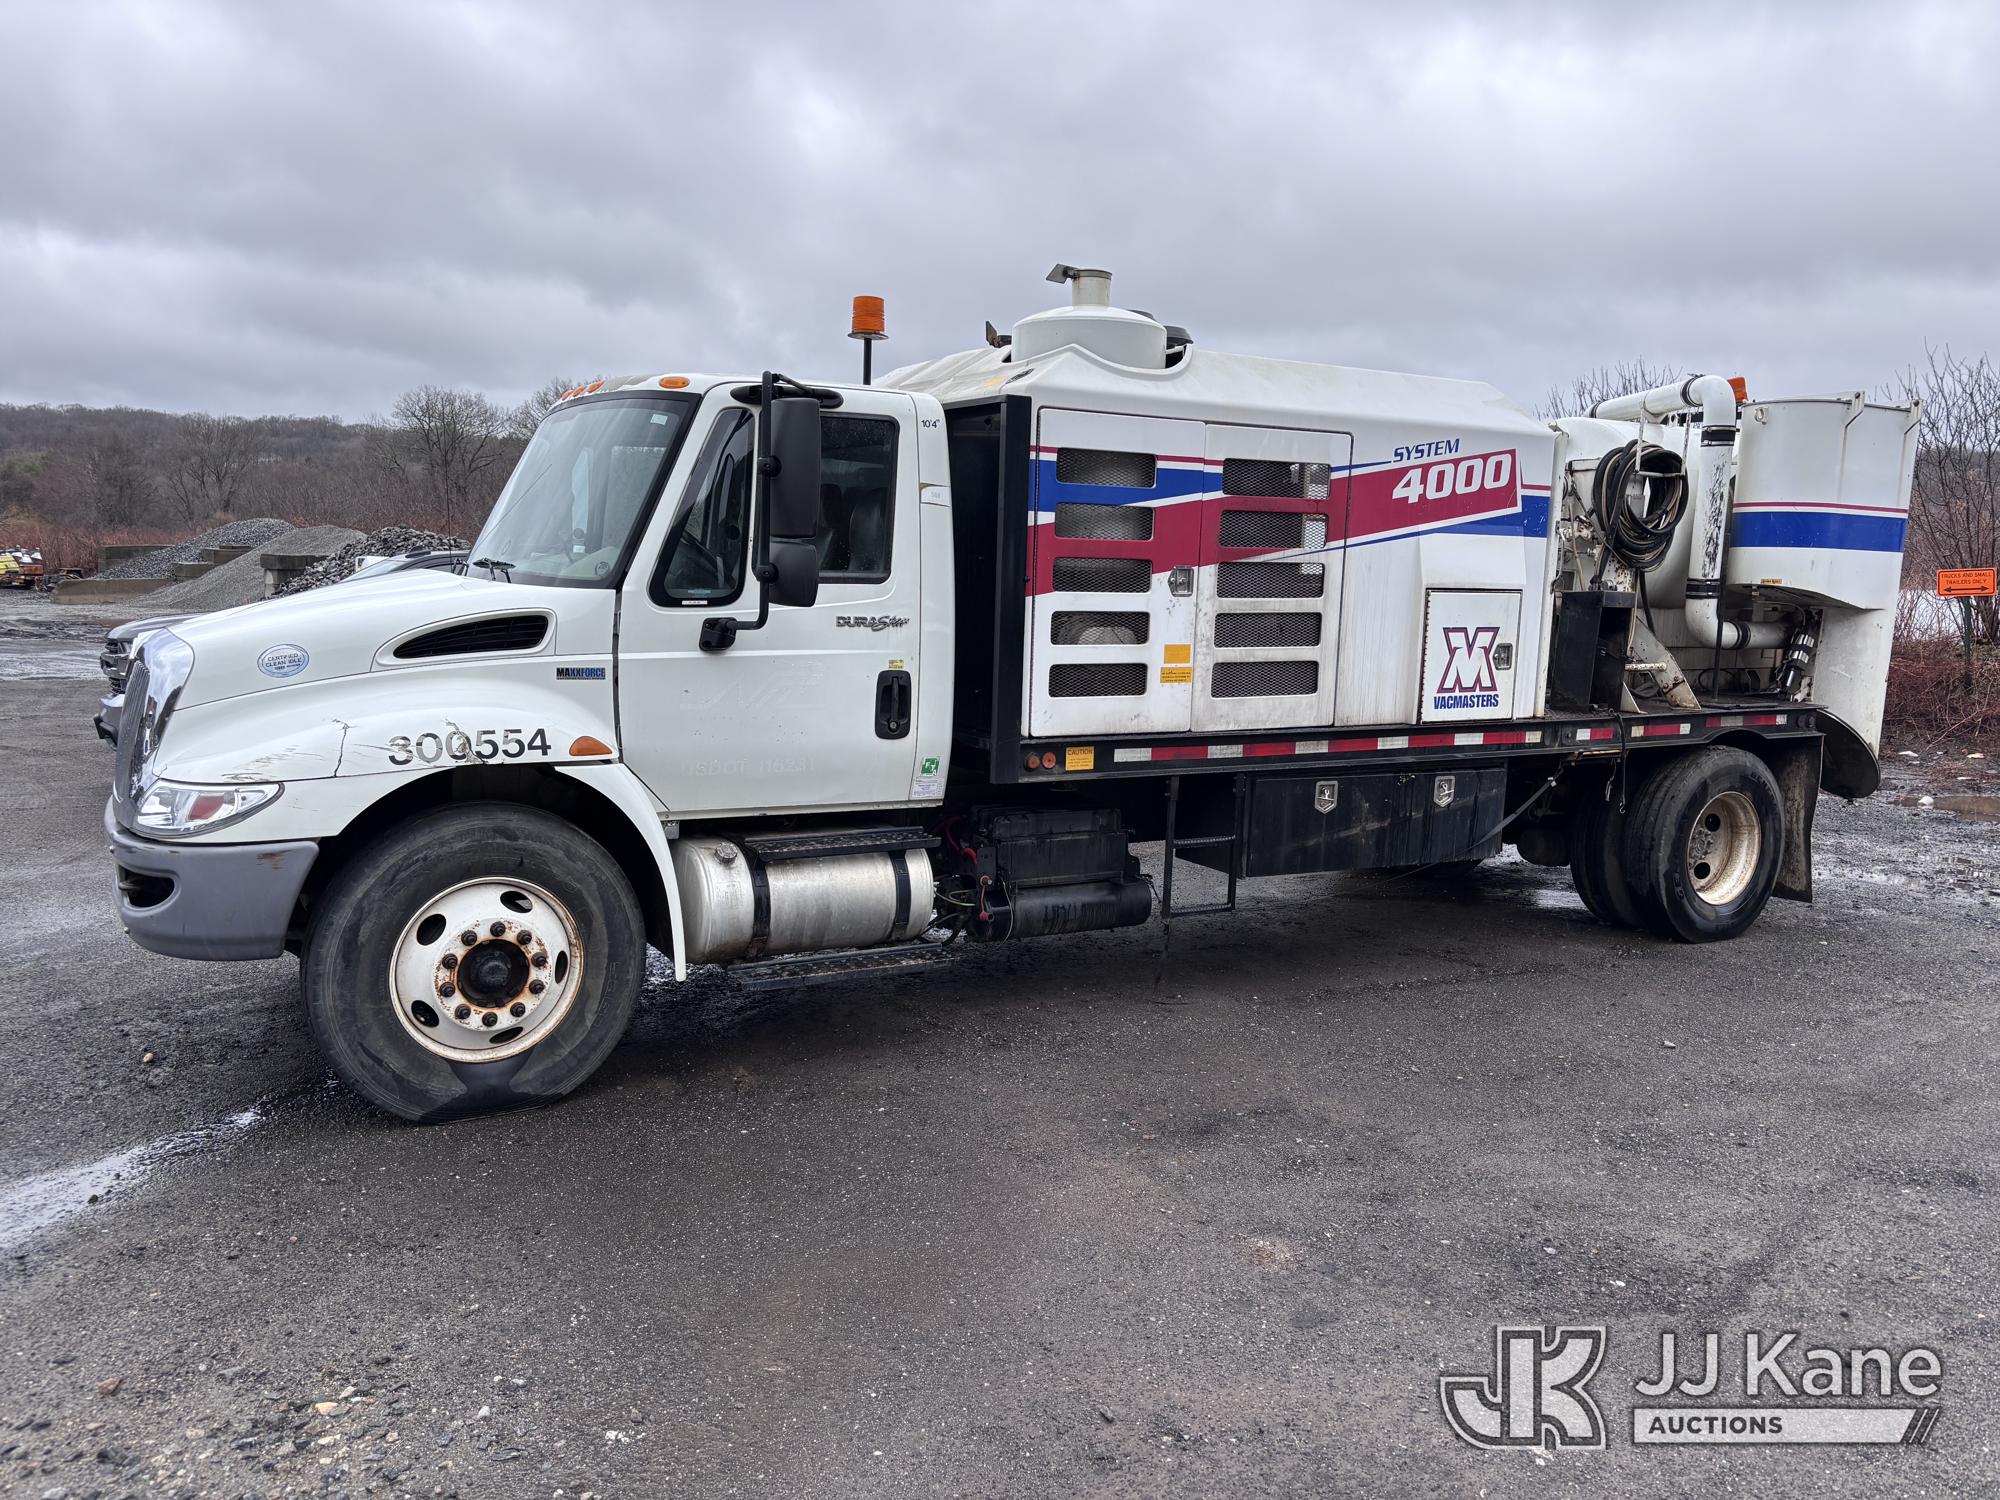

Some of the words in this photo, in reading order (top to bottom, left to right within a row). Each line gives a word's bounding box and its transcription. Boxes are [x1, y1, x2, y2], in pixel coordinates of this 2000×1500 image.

[1393, 438, 1460, 463] SYSTEM
[1392, 453, 1512, 504] 4000
[265, 660, 287, 668] CLEAN
[556, 667, 606, 678] MAXXFORCE
[1433, 693, 1500, 710] VACMASTERS
[388, 728, 552, 766] 300554
[1067, 748, 1093, 756] CAUTION
